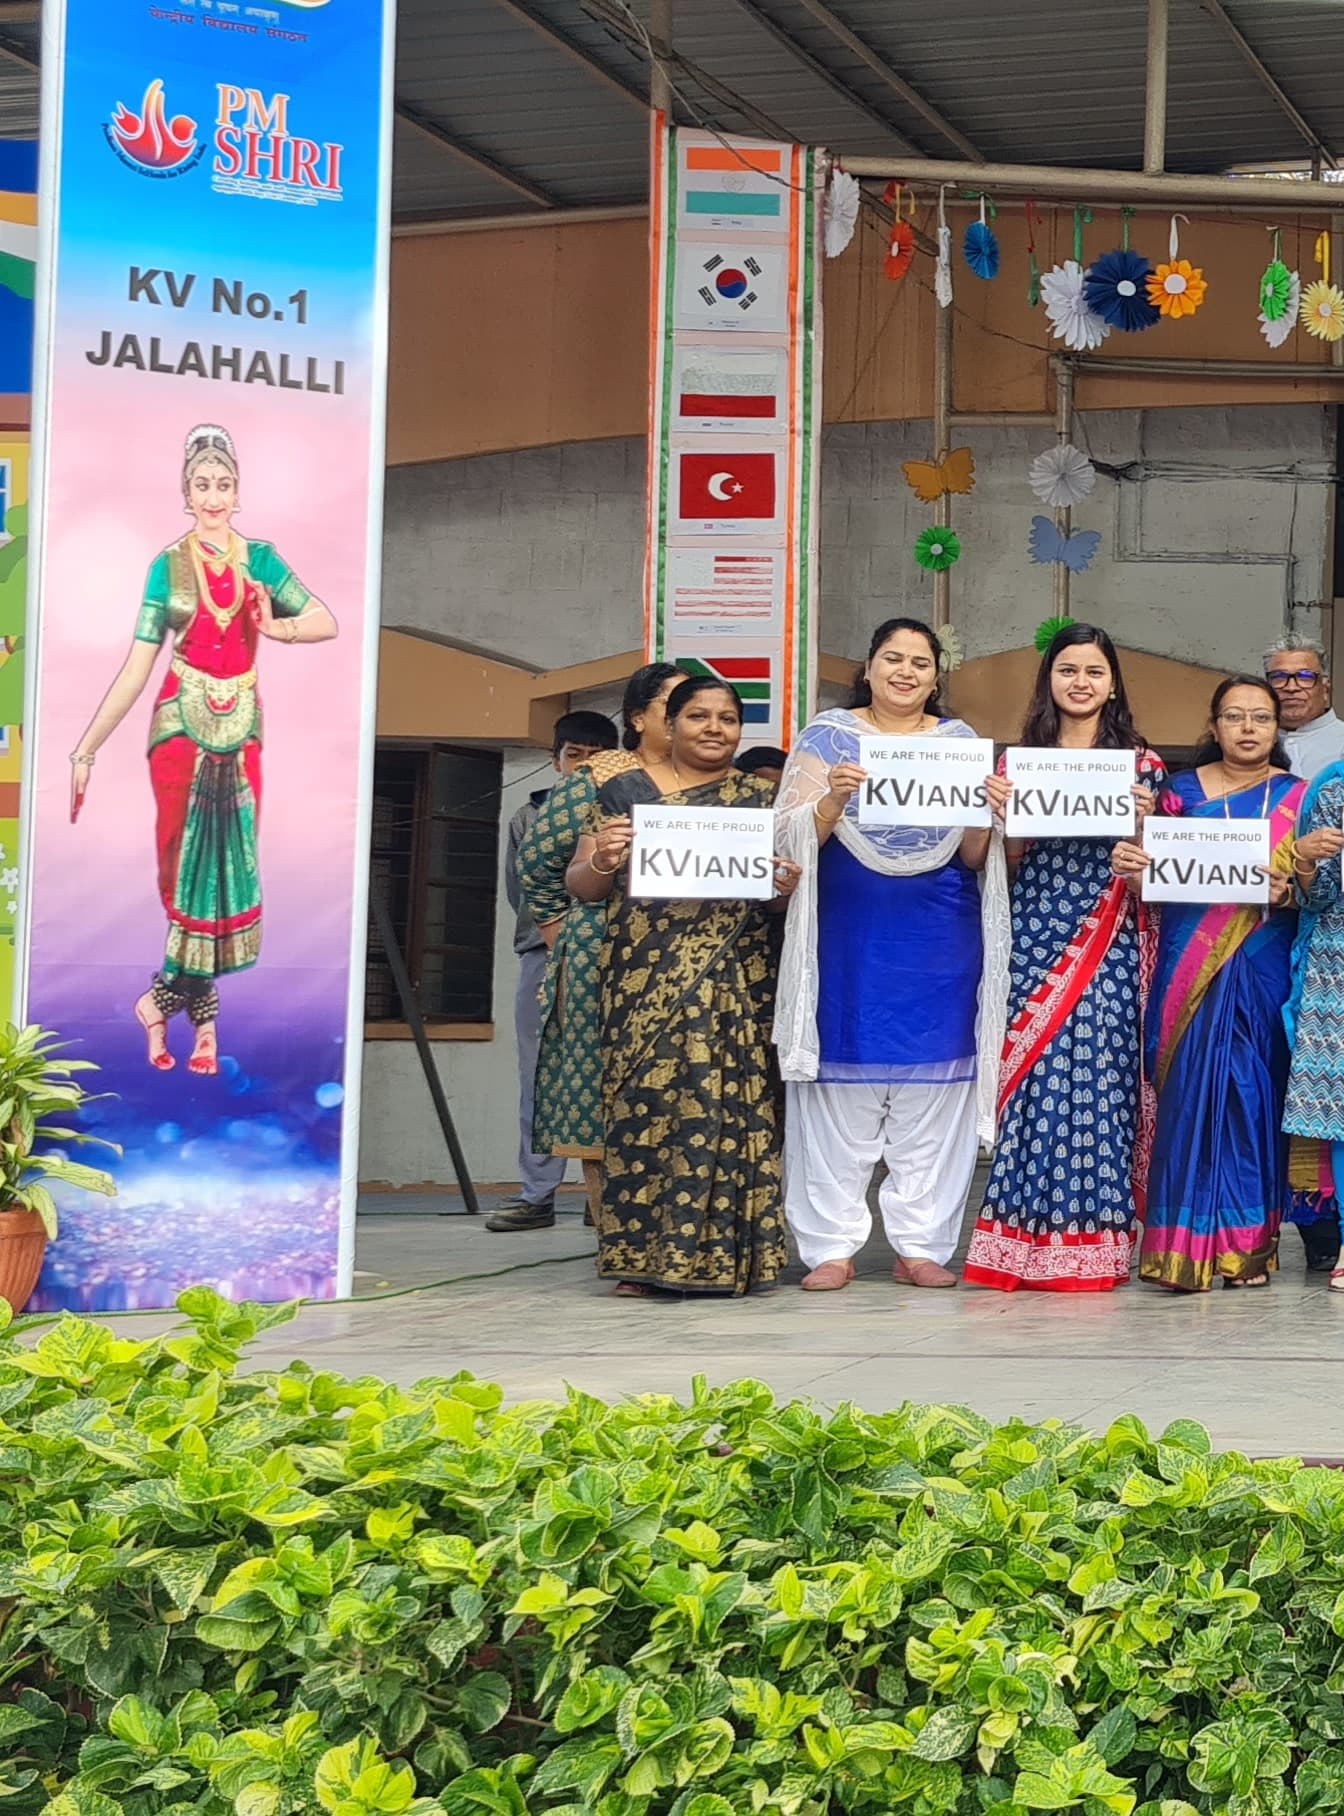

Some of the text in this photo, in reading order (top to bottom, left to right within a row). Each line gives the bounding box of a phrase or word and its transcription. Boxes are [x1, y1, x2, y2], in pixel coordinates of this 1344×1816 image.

[217, 84, 288, 135] PM
[215, 128, 342, 190] SHRI
[129, 266, 307, 324] KV No.1
[85, 331, 344, 394] JALAHALLI
[869, 750, 985, 762] WE ARE THE PROUD
[1016, 762, 1127, 772] WE ARE THE PROUD
[643, 819, 765, 832] WE ARE THE PROUD
[1152, 831, 1262, 842] WE ARE THE PROUD
